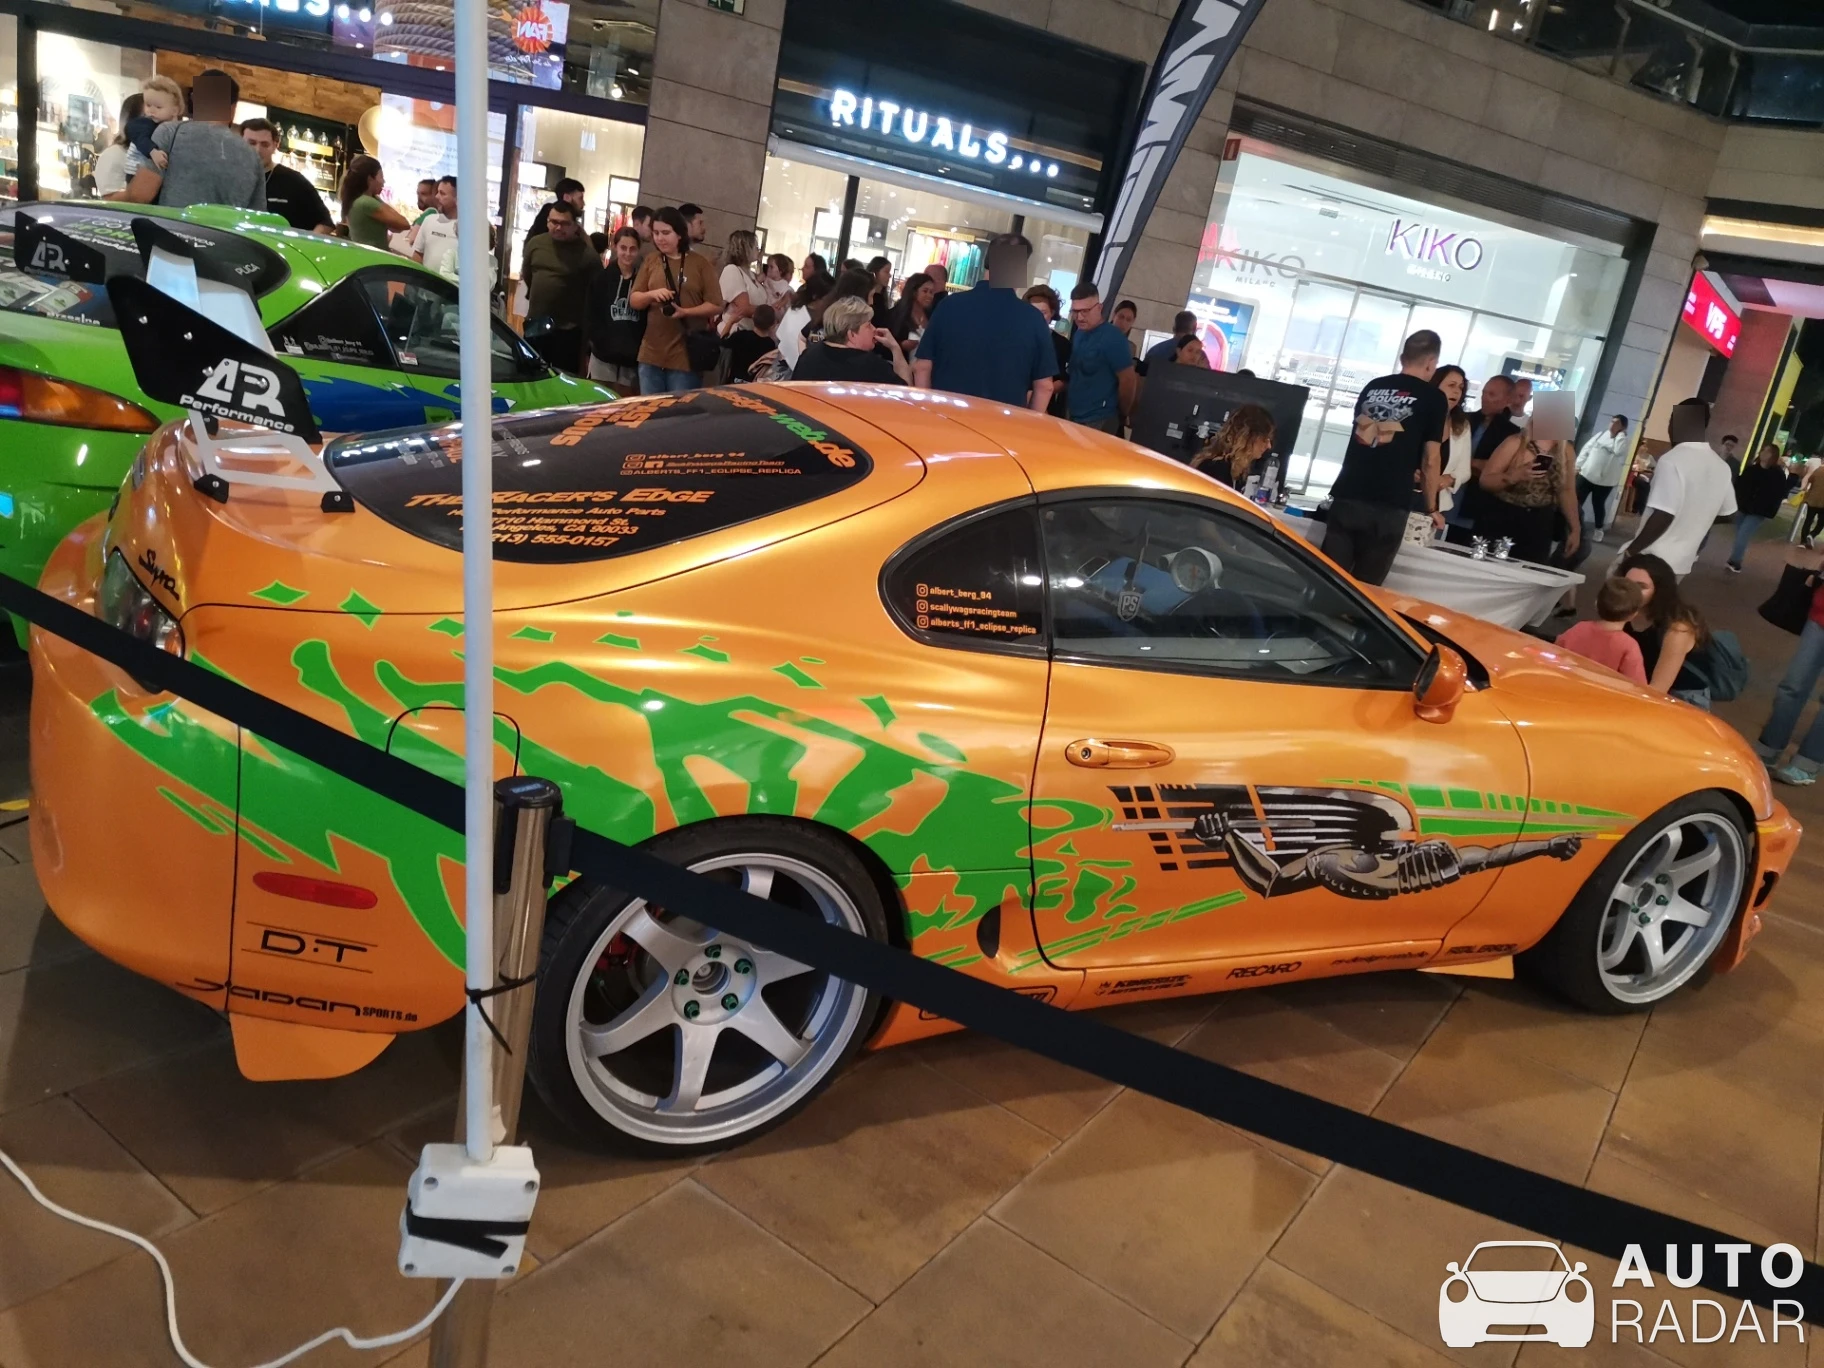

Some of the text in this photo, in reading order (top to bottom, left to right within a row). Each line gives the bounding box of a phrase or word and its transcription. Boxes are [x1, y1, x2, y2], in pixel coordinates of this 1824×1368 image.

[1384, 218, 1483, 271] KIKO
[1213, 246, 1306, 279] KIKO
[196, 357, 286, 418] AR
[1366, 388, 1399, 397] BUILT
[1368, 395, 1418, 405] BOUGHT
[179, 394, 295, 433] Performance
[620, 488, 716, 503] EDGE
[625, 508, 667, 516] Parts
[590, 526, 640, 534] 90033
[531, 535, 620, 547] 555-0157
[1226, 961, 1303, 980] RECARO
